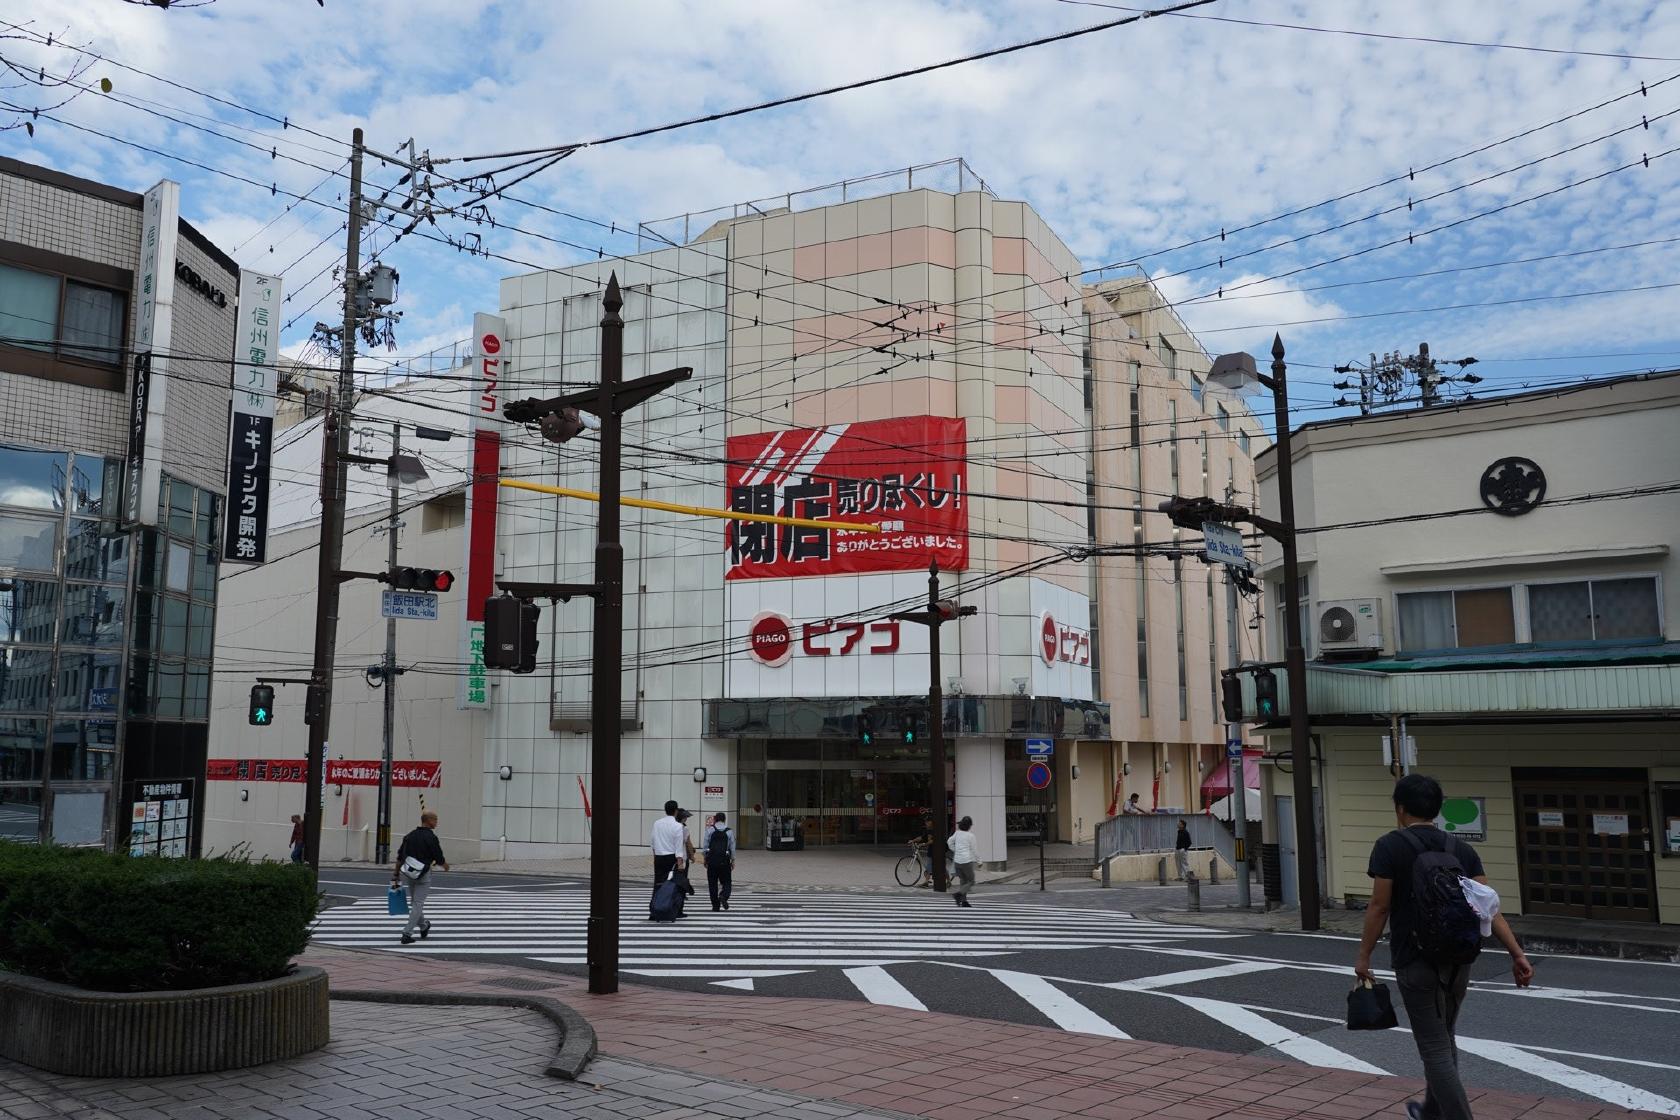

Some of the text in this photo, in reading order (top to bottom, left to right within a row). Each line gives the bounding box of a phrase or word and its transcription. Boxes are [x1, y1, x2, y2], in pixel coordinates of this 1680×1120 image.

[236, 429, 261, 558] キノシタ開発
[731, 476, 833, 566] 閉店
[836, 535, 963, 553] ありがとうございました。
[393, 594, 435, 608] 飯田駅北
[756, 632, 786, 644] PIAGO
[1060, 626, 1090, 665] ピアゴ
